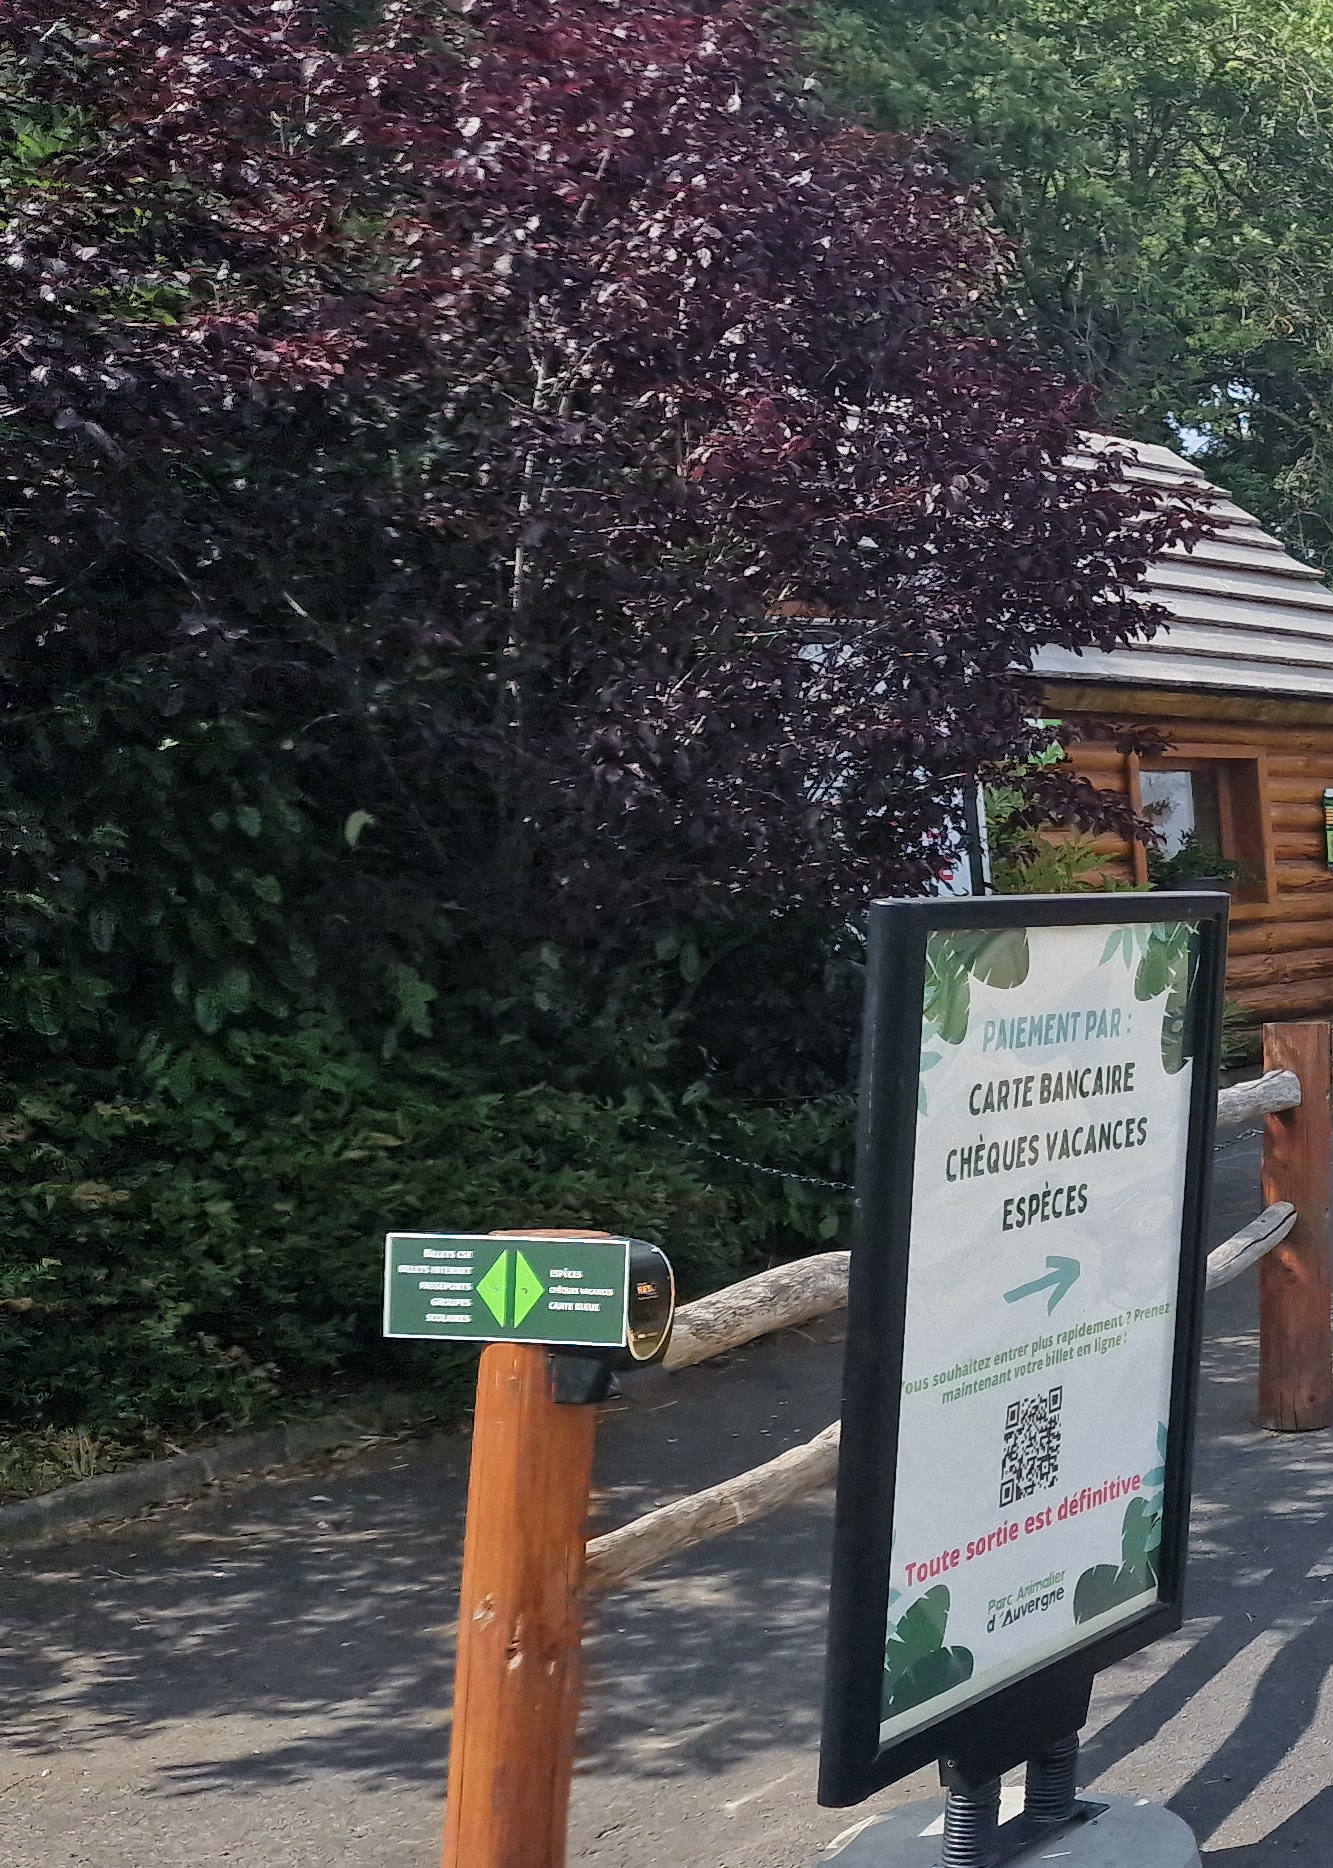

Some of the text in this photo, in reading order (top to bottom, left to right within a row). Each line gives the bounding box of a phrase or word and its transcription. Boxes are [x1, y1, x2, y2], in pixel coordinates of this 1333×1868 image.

[982, 1010, 1082, 1053] PAIEMENT
[1084, 1007, 1123, 1039] PAR
[968, 1061, 1137, 1117] CARTE BANCAIRE
[944, 1116, 1149, 1183] CHÈQUES VACANCES
[1001, 1180, 1089, 1232] ESPÈCES
[932, 1356, 992, 1387] souhaitez
[993, 1343, 1030, 1366] entrer
[1031, 1335, 1054, 1358] plus
[1056, 1314, 1124, 1346] rapidement
[1133, 1302, 1171, 1323] Prenez
[941, 1371, 1013, 1405] maintenant
[1013, 1359, 1044, 1379] votre
[1045, 1347, 1075, 1368] billet
[1076, 1343, 1092, 1358] en
[1094, 1334, 1122, 1355] ligne
[904, 1472, 1142, 1588] Toute sortie est définitive
[987, 1569, 1066, 1615] Parc Animalier
